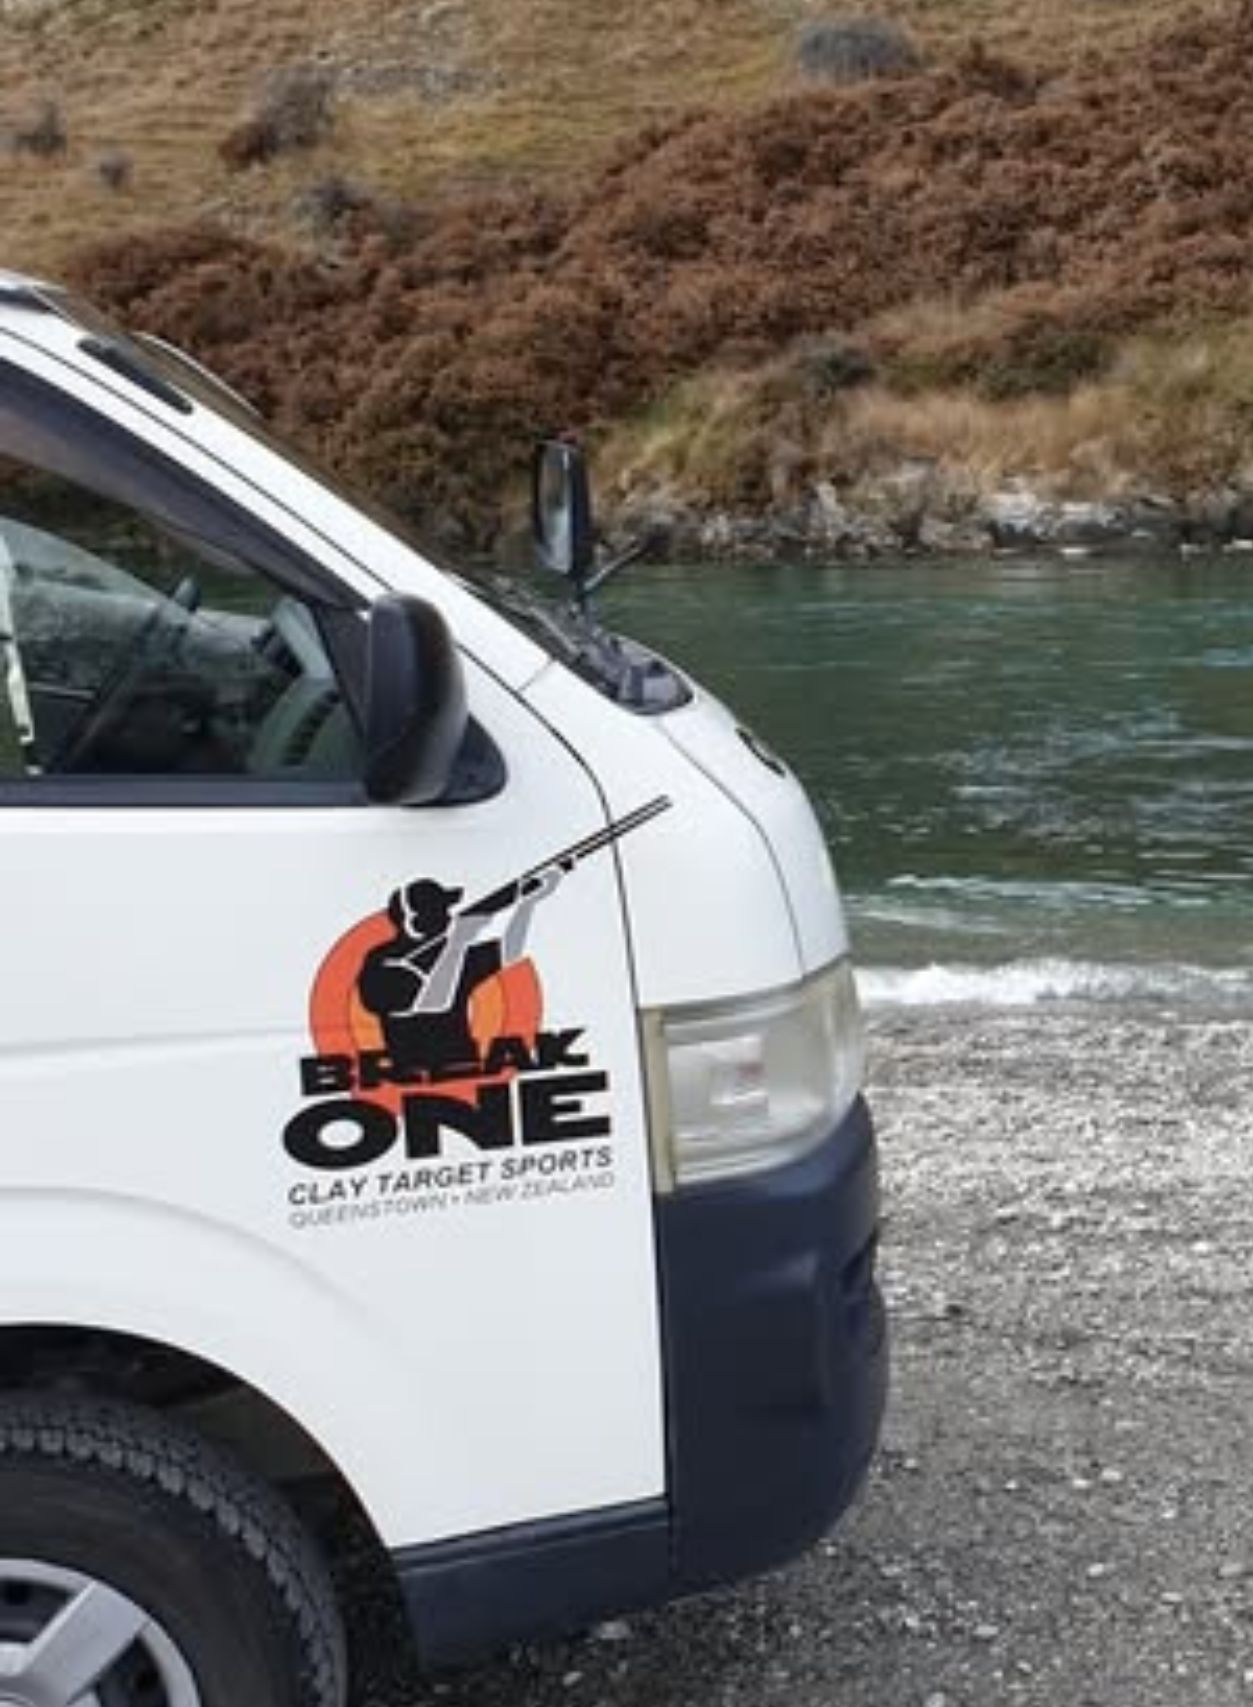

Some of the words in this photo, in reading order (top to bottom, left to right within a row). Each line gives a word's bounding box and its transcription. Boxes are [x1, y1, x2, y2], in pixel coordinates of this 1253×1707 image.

[299, 1028, 590, 1096] BREAK
[282, 1070, 612, 1170] ONE
[287, 1176, 367, 1206] CLAY
[376, 1160, 492, 1196] TARGET
[500, 1145, 613, 1181] SPORTS
[288, 1192, 449, 1229] QUEENSTOWN
[463, 1184, 518, 1205] NEW
[520, 1170, 614, 1200] ZEALAND
